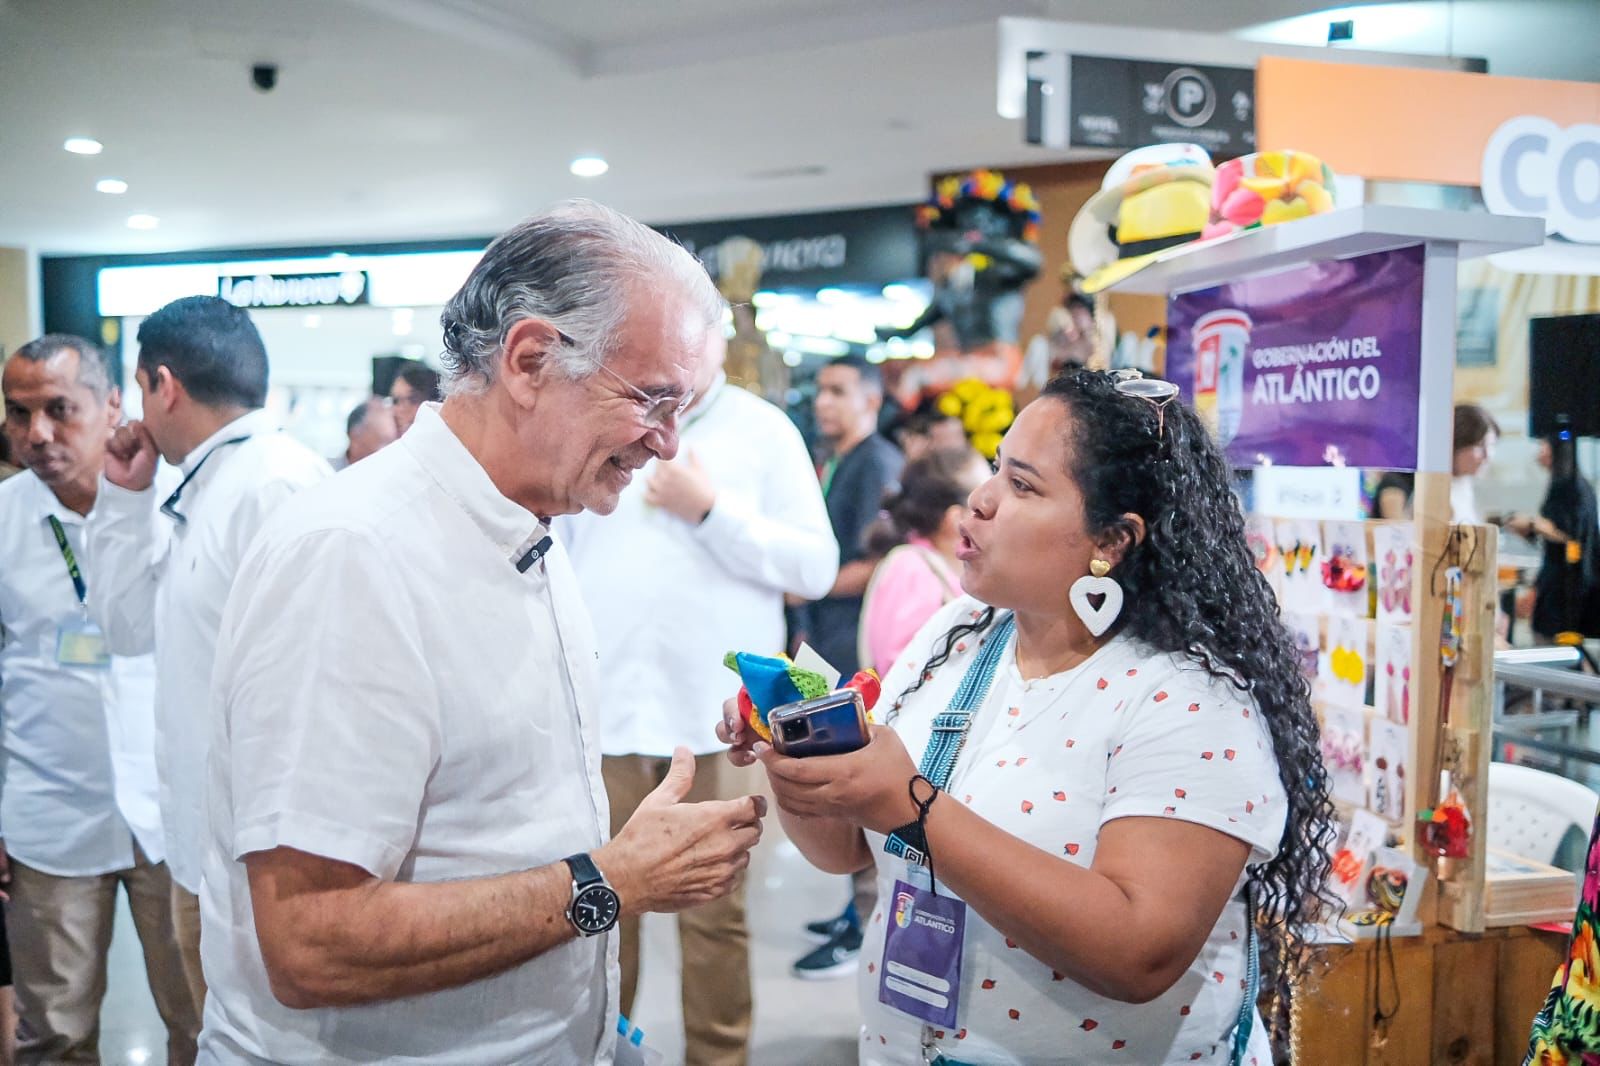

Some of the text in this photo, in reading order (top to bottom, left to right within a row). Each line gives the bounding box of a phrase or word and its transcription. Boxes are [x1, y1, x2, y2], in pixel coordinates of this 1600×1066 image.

[1252, 336, 1381, 369] GOBERNACIÓN DEL
[1253, 363, 1381, 405] ATLÁNTICO
